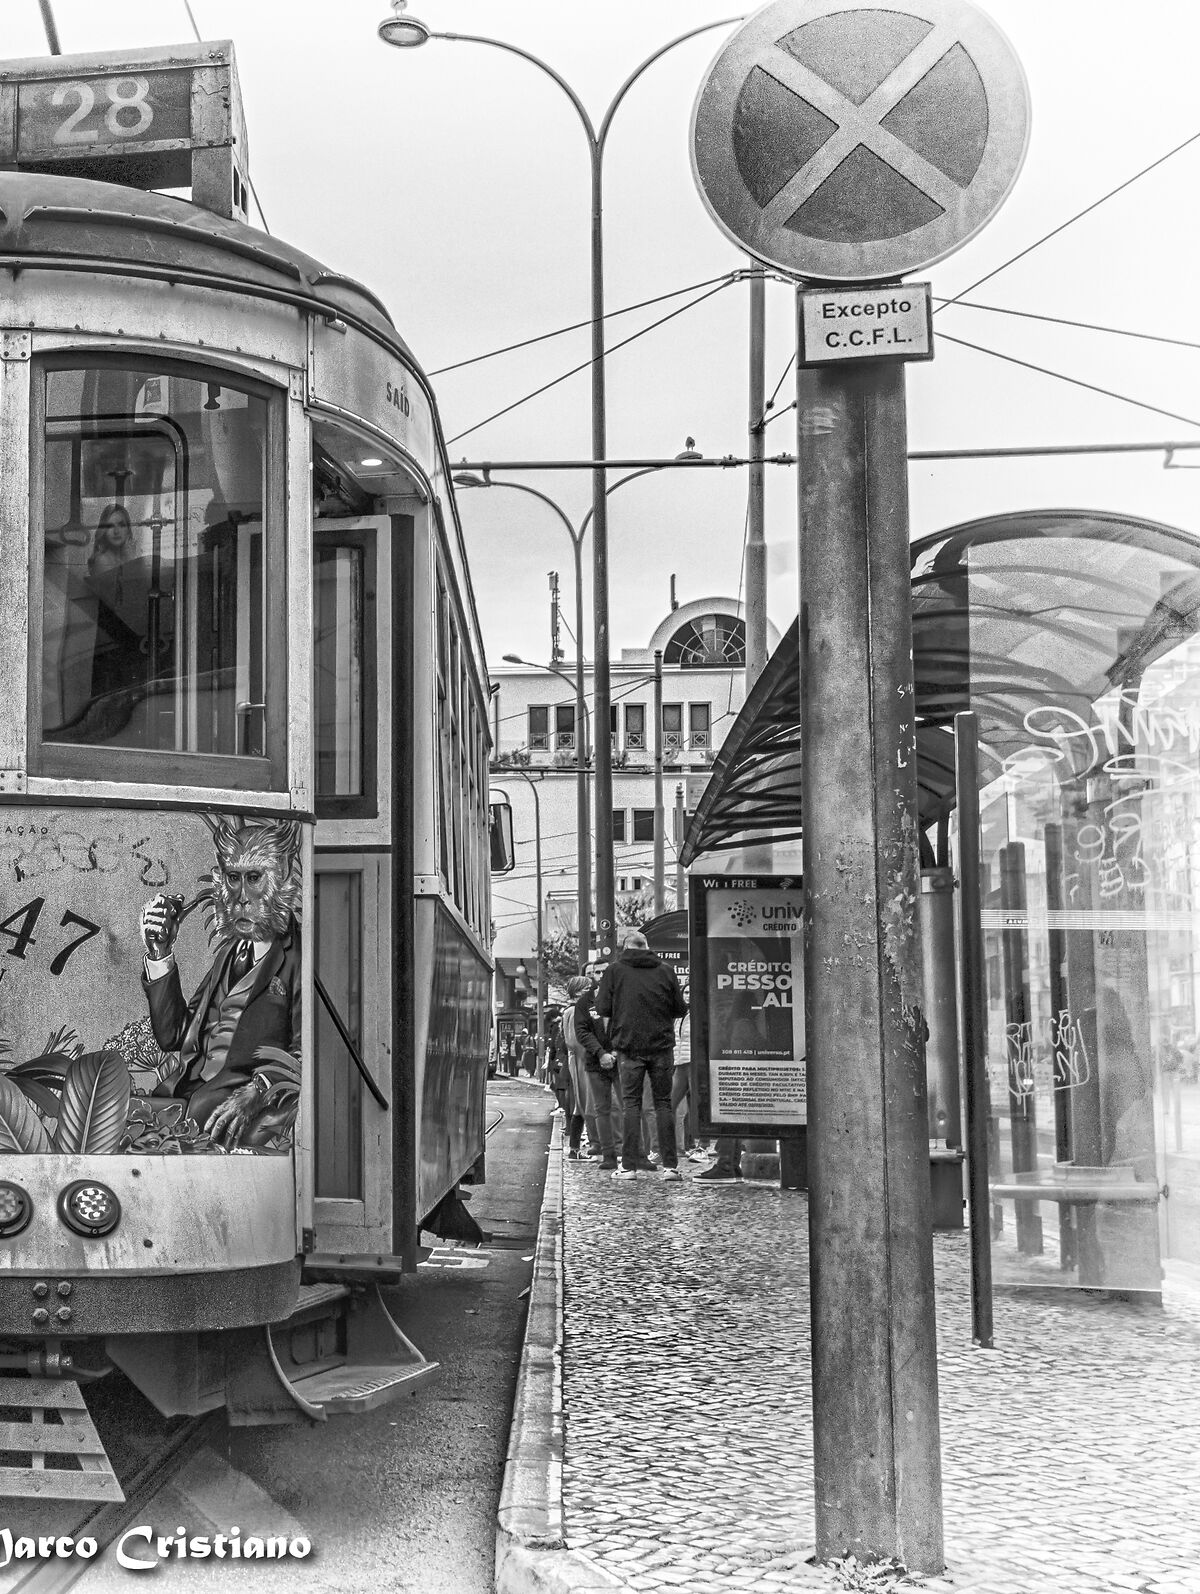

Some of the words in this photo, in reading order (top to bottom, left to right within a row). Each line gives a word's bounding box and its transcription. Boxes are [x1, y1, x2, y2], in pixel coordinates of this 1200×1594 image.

[51, 75, 154, 144] 28
[822, 299, 912, 319] Excepto
[825, 327, 912, 348] C.C.F.L.
[731, 879, 757, 888] FREE
[727, 959, 792, 972] CRÉDITO
[716, 974, 793, 990] PESSO
